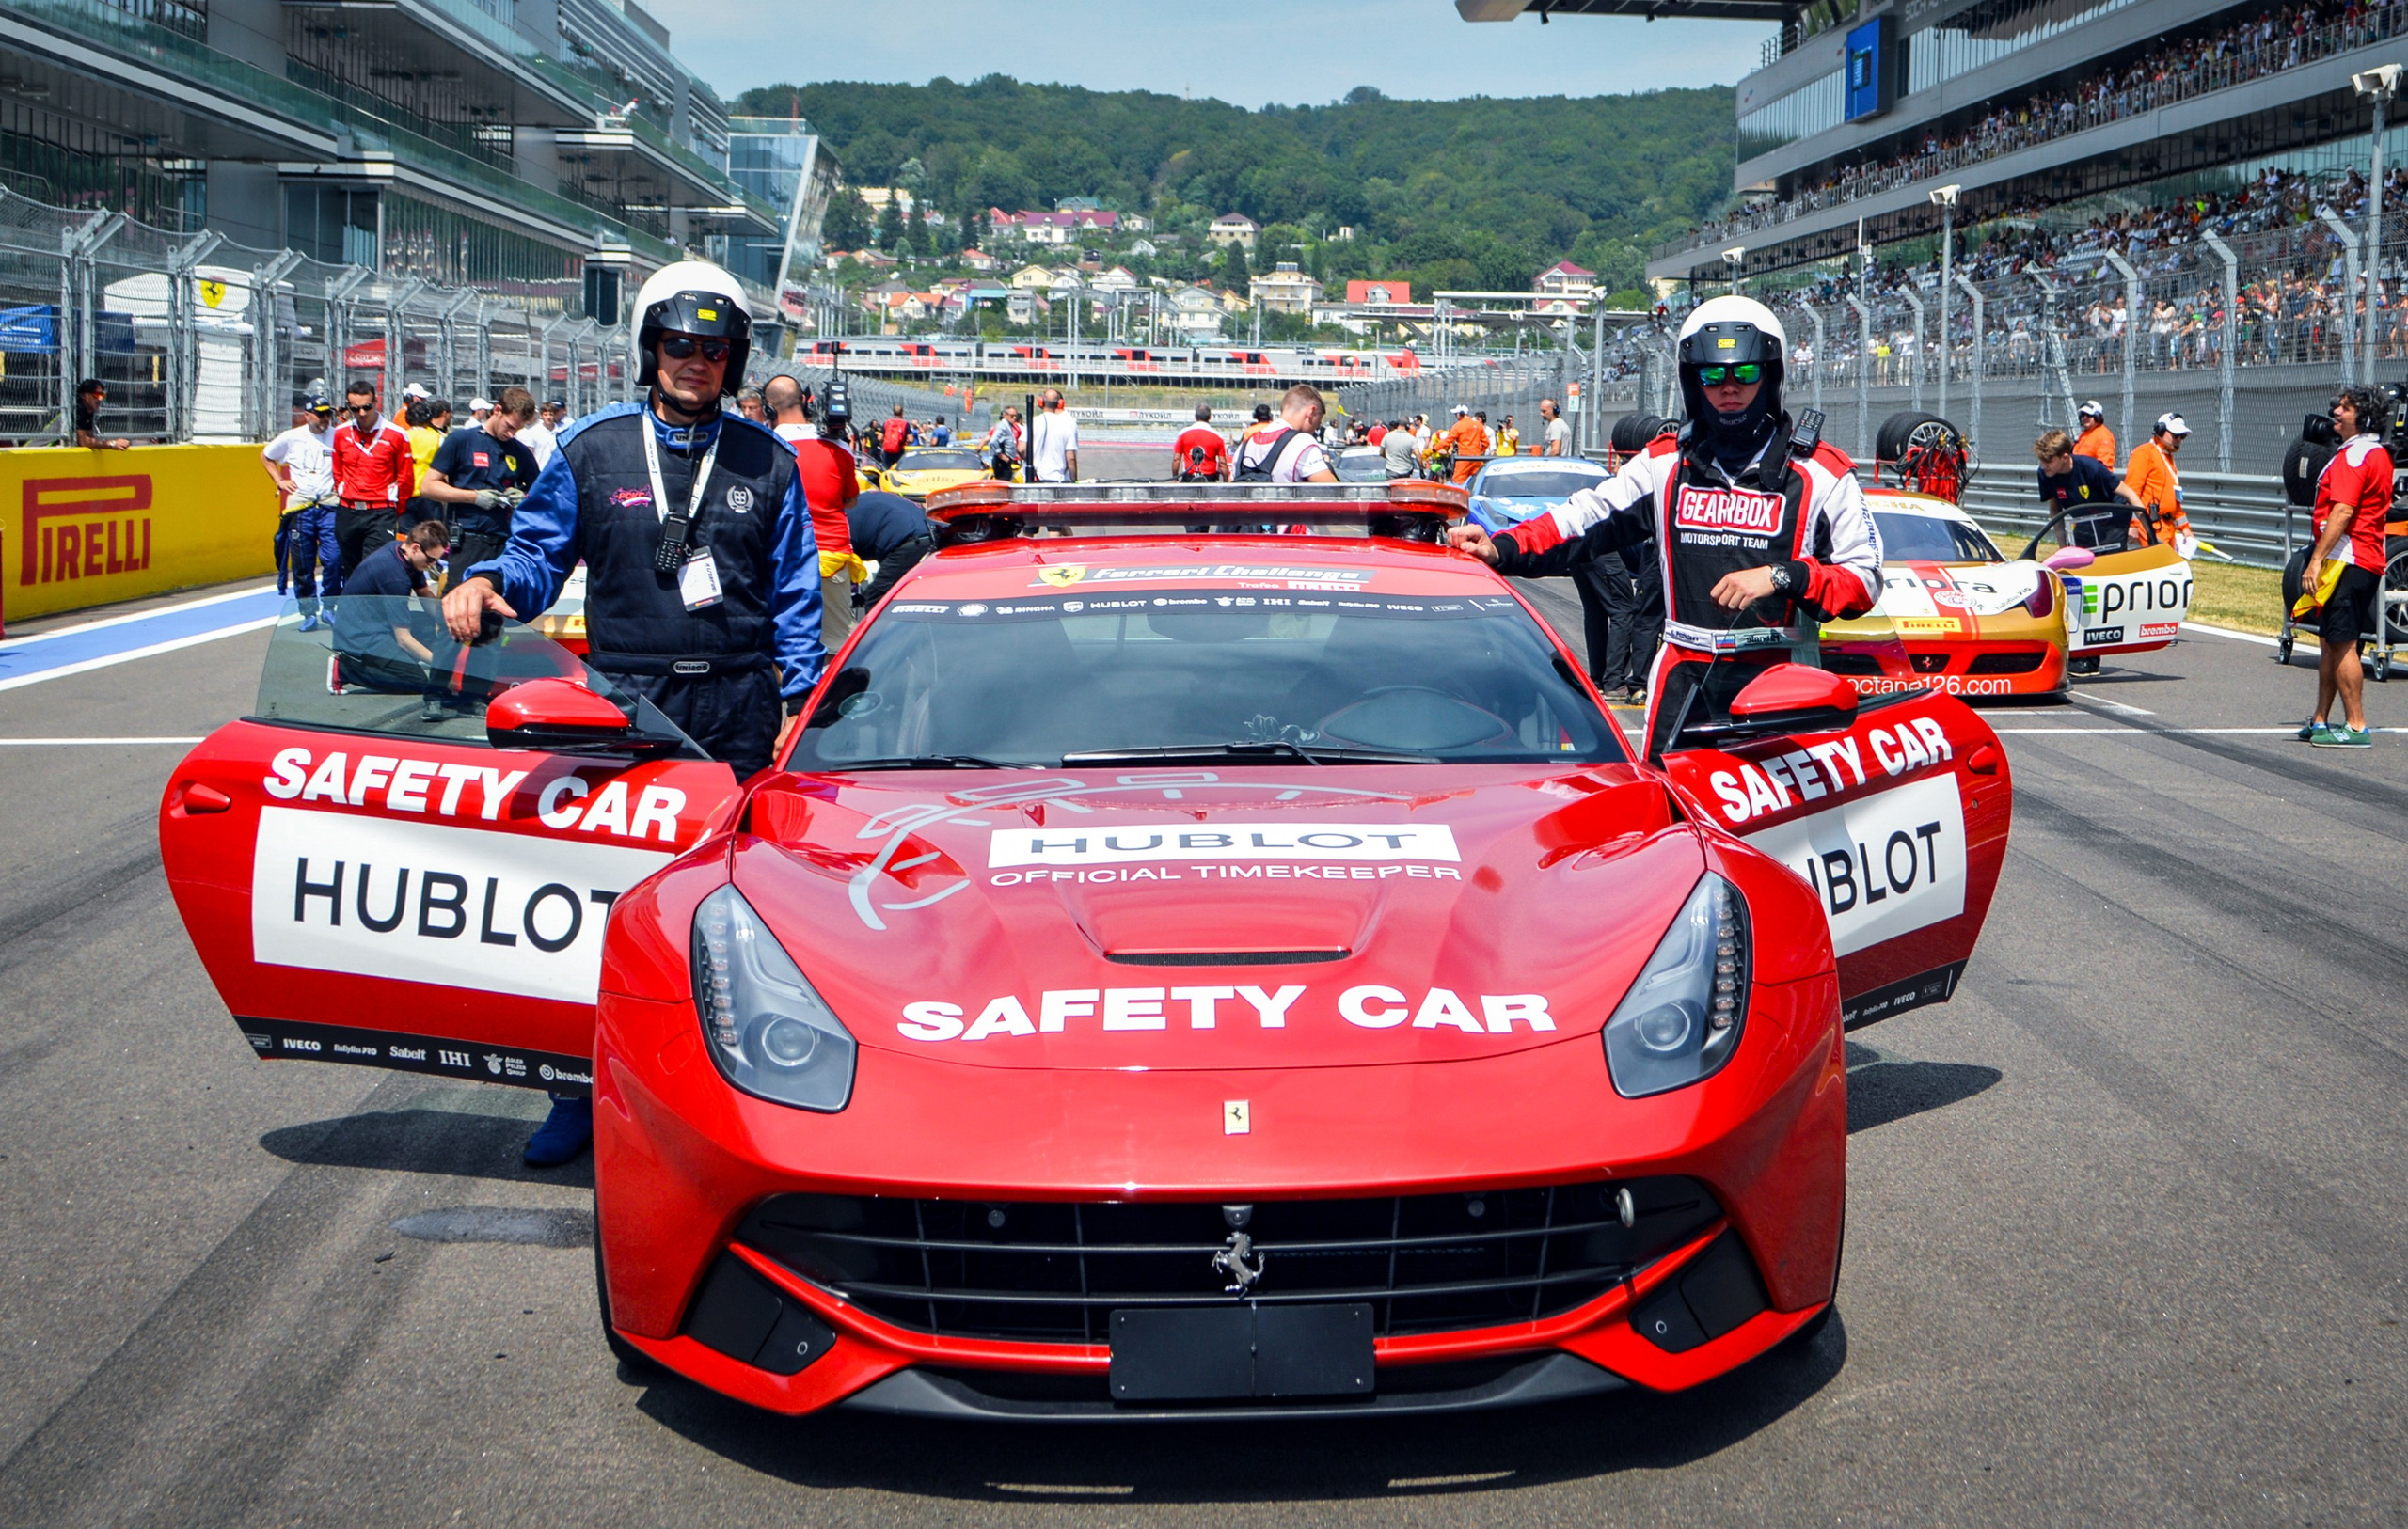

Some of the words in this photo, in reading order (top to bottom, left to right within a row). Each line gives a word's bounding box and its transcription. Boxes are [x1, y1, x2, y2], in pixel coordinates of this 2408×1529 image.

[1212, 412, 1240, 420] УКОЙЛ
[1682, 491, 1775, 528] GEARBOX
[20, 474, 152, 586] PIRELLI
[1680, 532, 1741, 547] MOTORSPORT
[1743, 536, 1768, 550] TEAM
[1093, 567, 1209, 578] Ferrari
[1213, 565, 1360, 581] Challenge
[1288, 580, 1361, 592] PIRELLI
[1884, 577, 1998, 594] riora
[1090, 600, 1147, 609] HUBLOT
[1387, 604, 1424, 612] IVECO
[1903, 620, 1955, 629] PIRELLI
[2140, 625, 2177, 637] brembo
[2086, 631, 2122, 641] IVECO
[1710, 736, 1867, 823] SAFETY
[1868, 717, 1954, 777] CAR
[263, 748, 529, 821] SAFETY
[537, 776, 687, 842] CAR
[1031, 832, 1418, 854] HUBLOT
[990, 866, 1182, 887] OFFICIAL
[1190, 864, 1463, 882] TIMEKEEPER
[1893, 991, 1916, 1006] IVECO
[896, 985, 1307, 1042] SAFETY
[1336, 984, 1558, 1035] CAR
[283, 1038, 322, 1051] IVECO
[389, 1045, 427, 1061] Sabelt
[438, 1049, 472, 1067] IHI
[506, 1068, 527, 1077] GROUP
